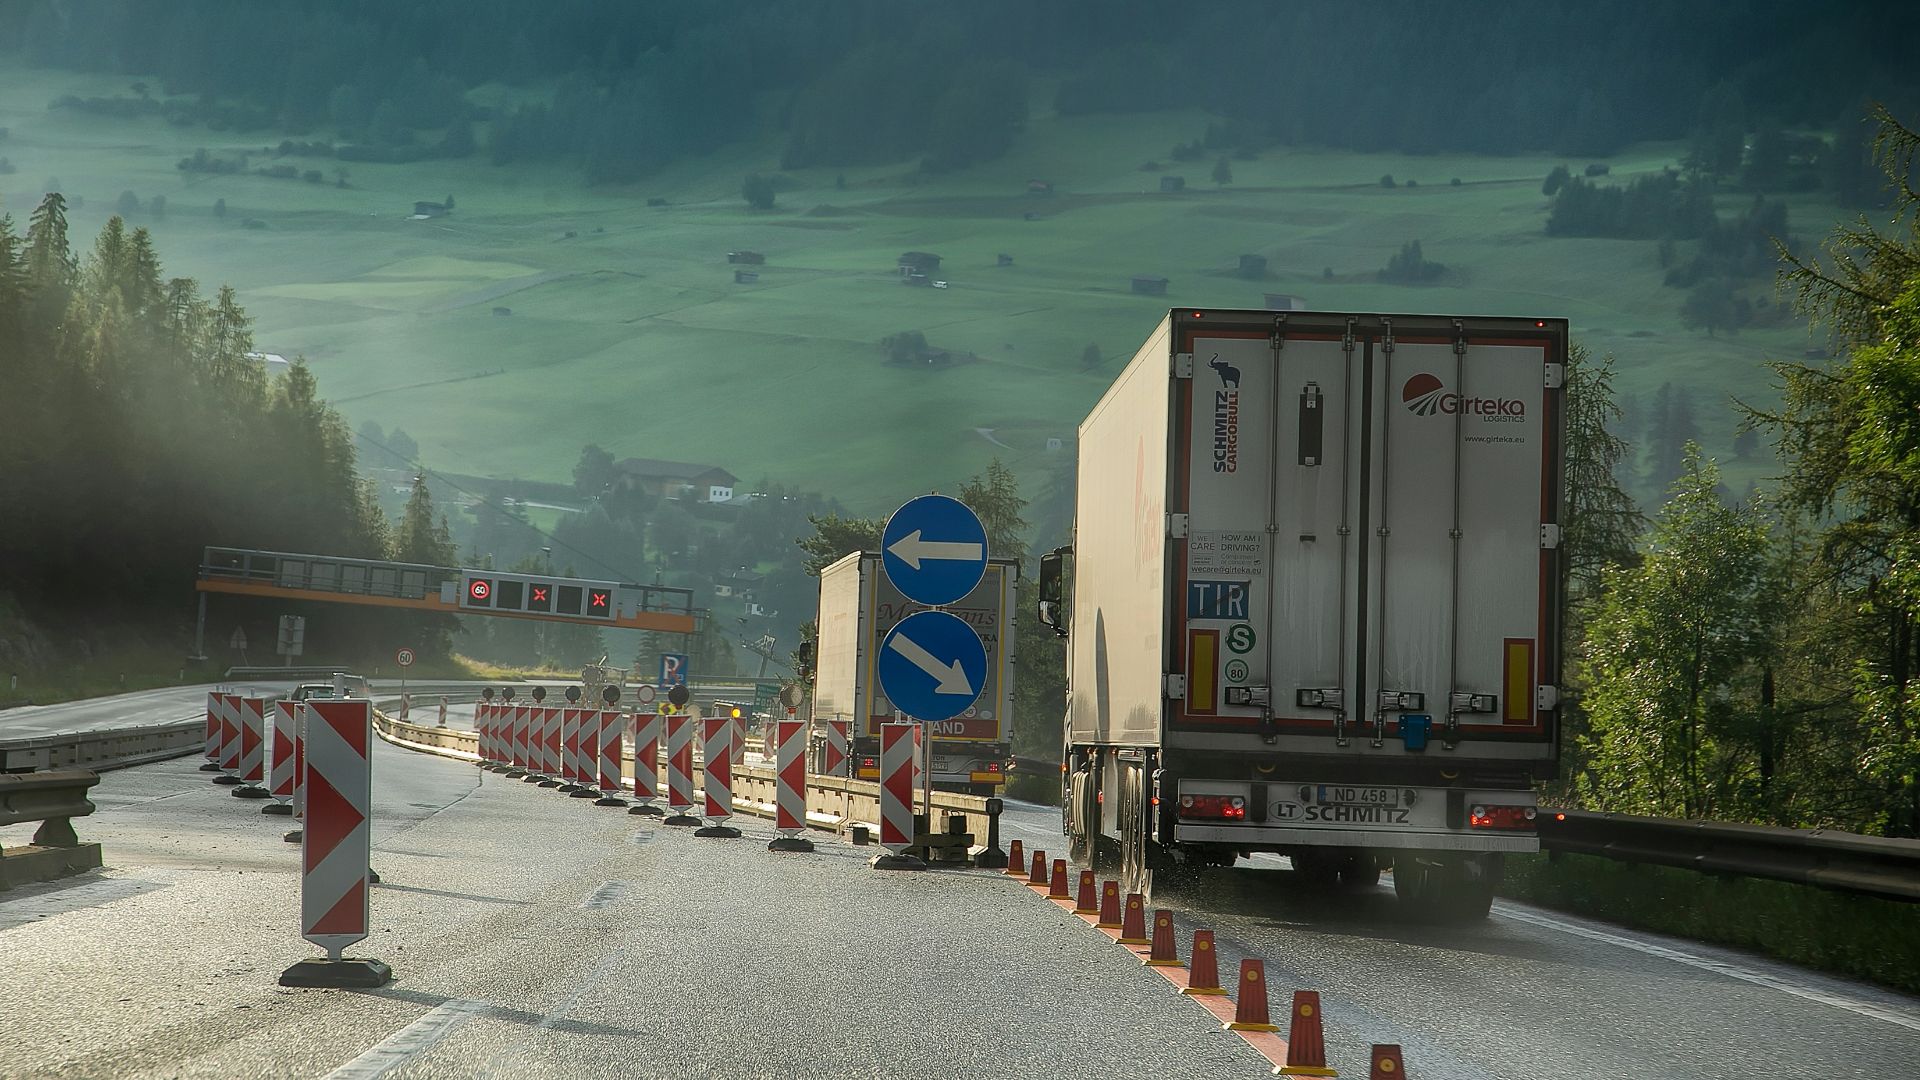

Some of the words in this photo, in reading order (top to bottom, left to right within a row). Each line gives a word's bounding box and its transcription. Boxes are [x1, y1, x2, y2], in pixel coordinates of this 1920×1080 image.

[1440, 393, 1525, 416] Girteka
[1483, 415, 1525, 423] LOGISTICS
[1214, 390, 1228, 473] SCHMITZ
[1227, 391, 1239, 473] CARGOBULL
[1464, 435, 1525, 444] www.girteka.eu
[1221, 534, 1241, 542] HOW
[1190, 542, 1215, 551] CARE
[1221, 543, 1260, 552] DRIVING?
[1193, 583, 1244, 617] TIR
[1231, 627, 1250, 651] S
[400, 652, 411, 663] 60
[663, 655, 680, 680] P
[1230, 669, 1243, 679] 80
[1334, 788, 1356, 802] ND
[1361, 789, 1388, 803] 458
[1277, 803, 1297, 818] LT
[1305, 805, 1410, 824] SCHMITZ
